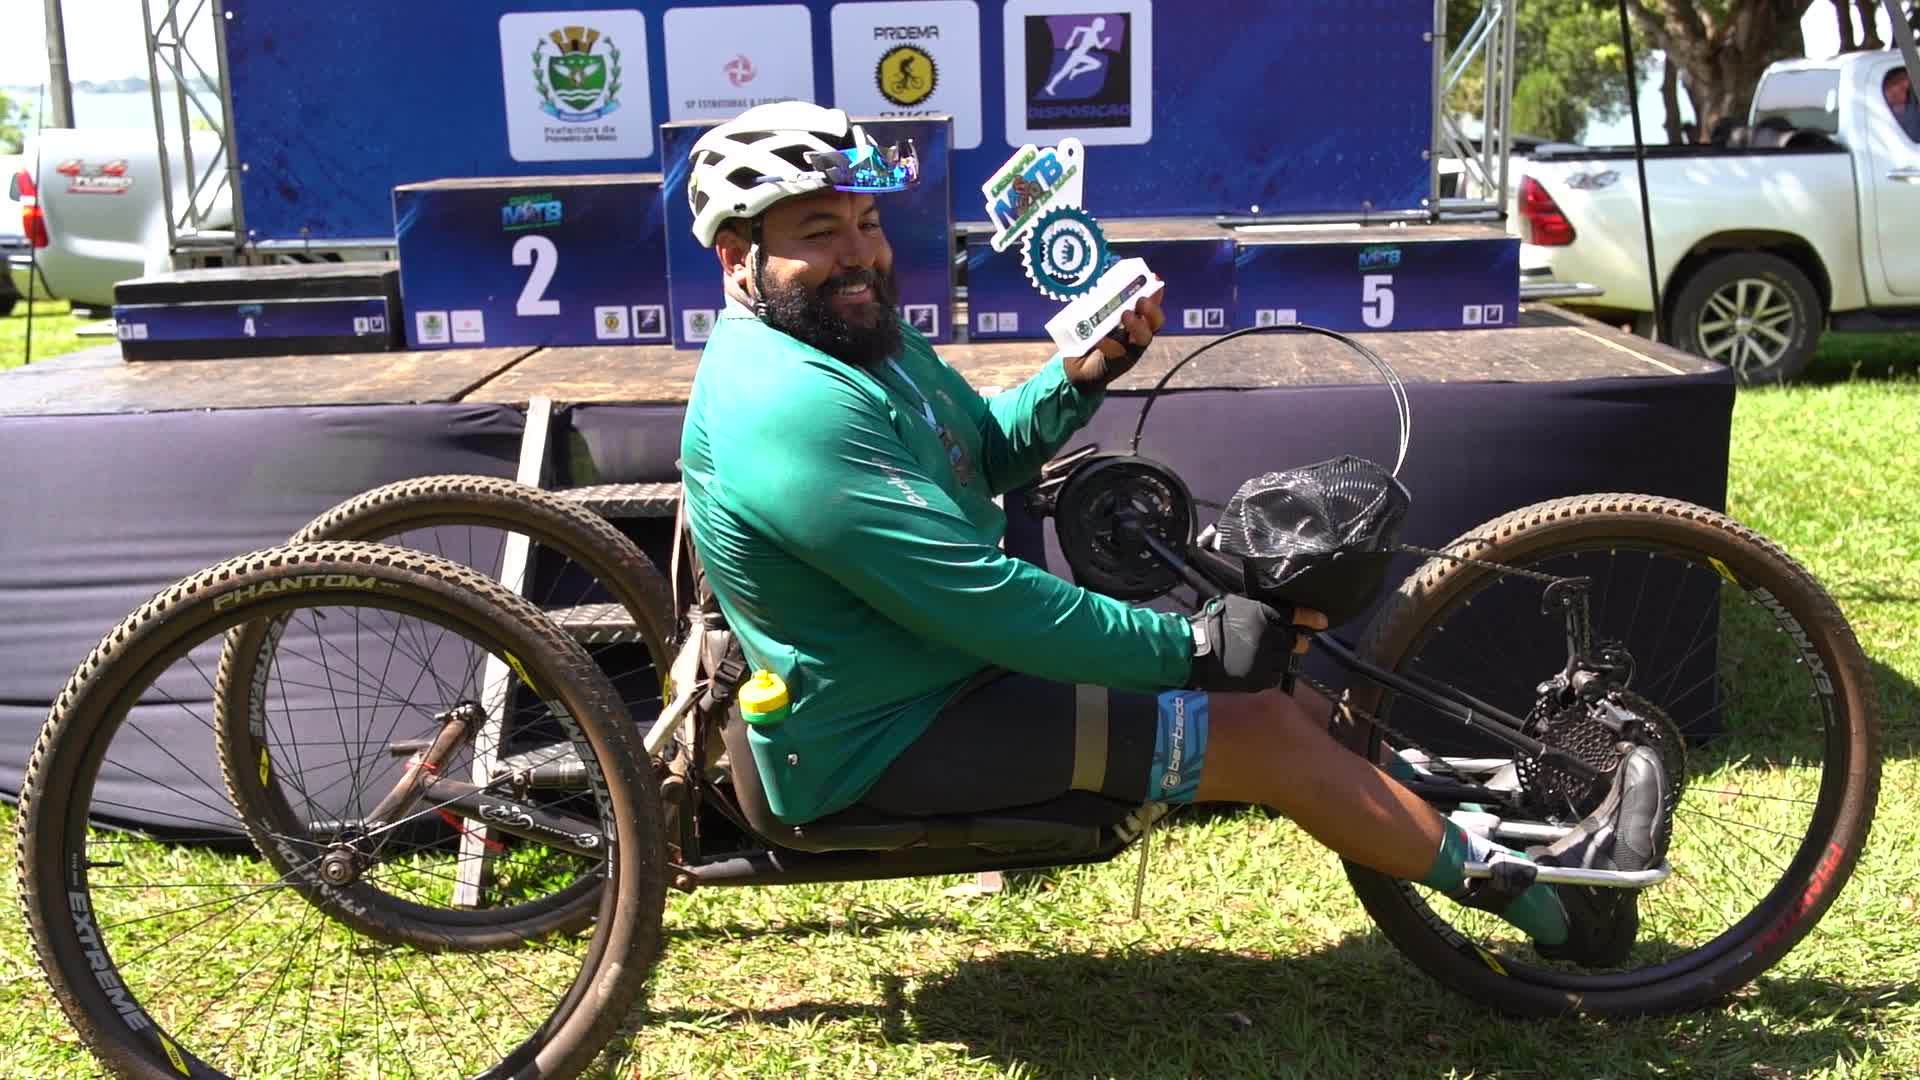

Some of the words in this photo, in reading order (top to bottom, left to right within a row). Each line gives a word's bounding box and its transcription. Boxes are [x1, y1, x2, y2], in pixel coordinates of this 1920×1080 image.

[511, 234, 561, 317] 2
[1362, 274, 1395, 329] 5
[243, 317, 256, 337] 4
[213, 573, 378, 614] PHANTOM
[67, 890, 151, 1033] EXTREME
